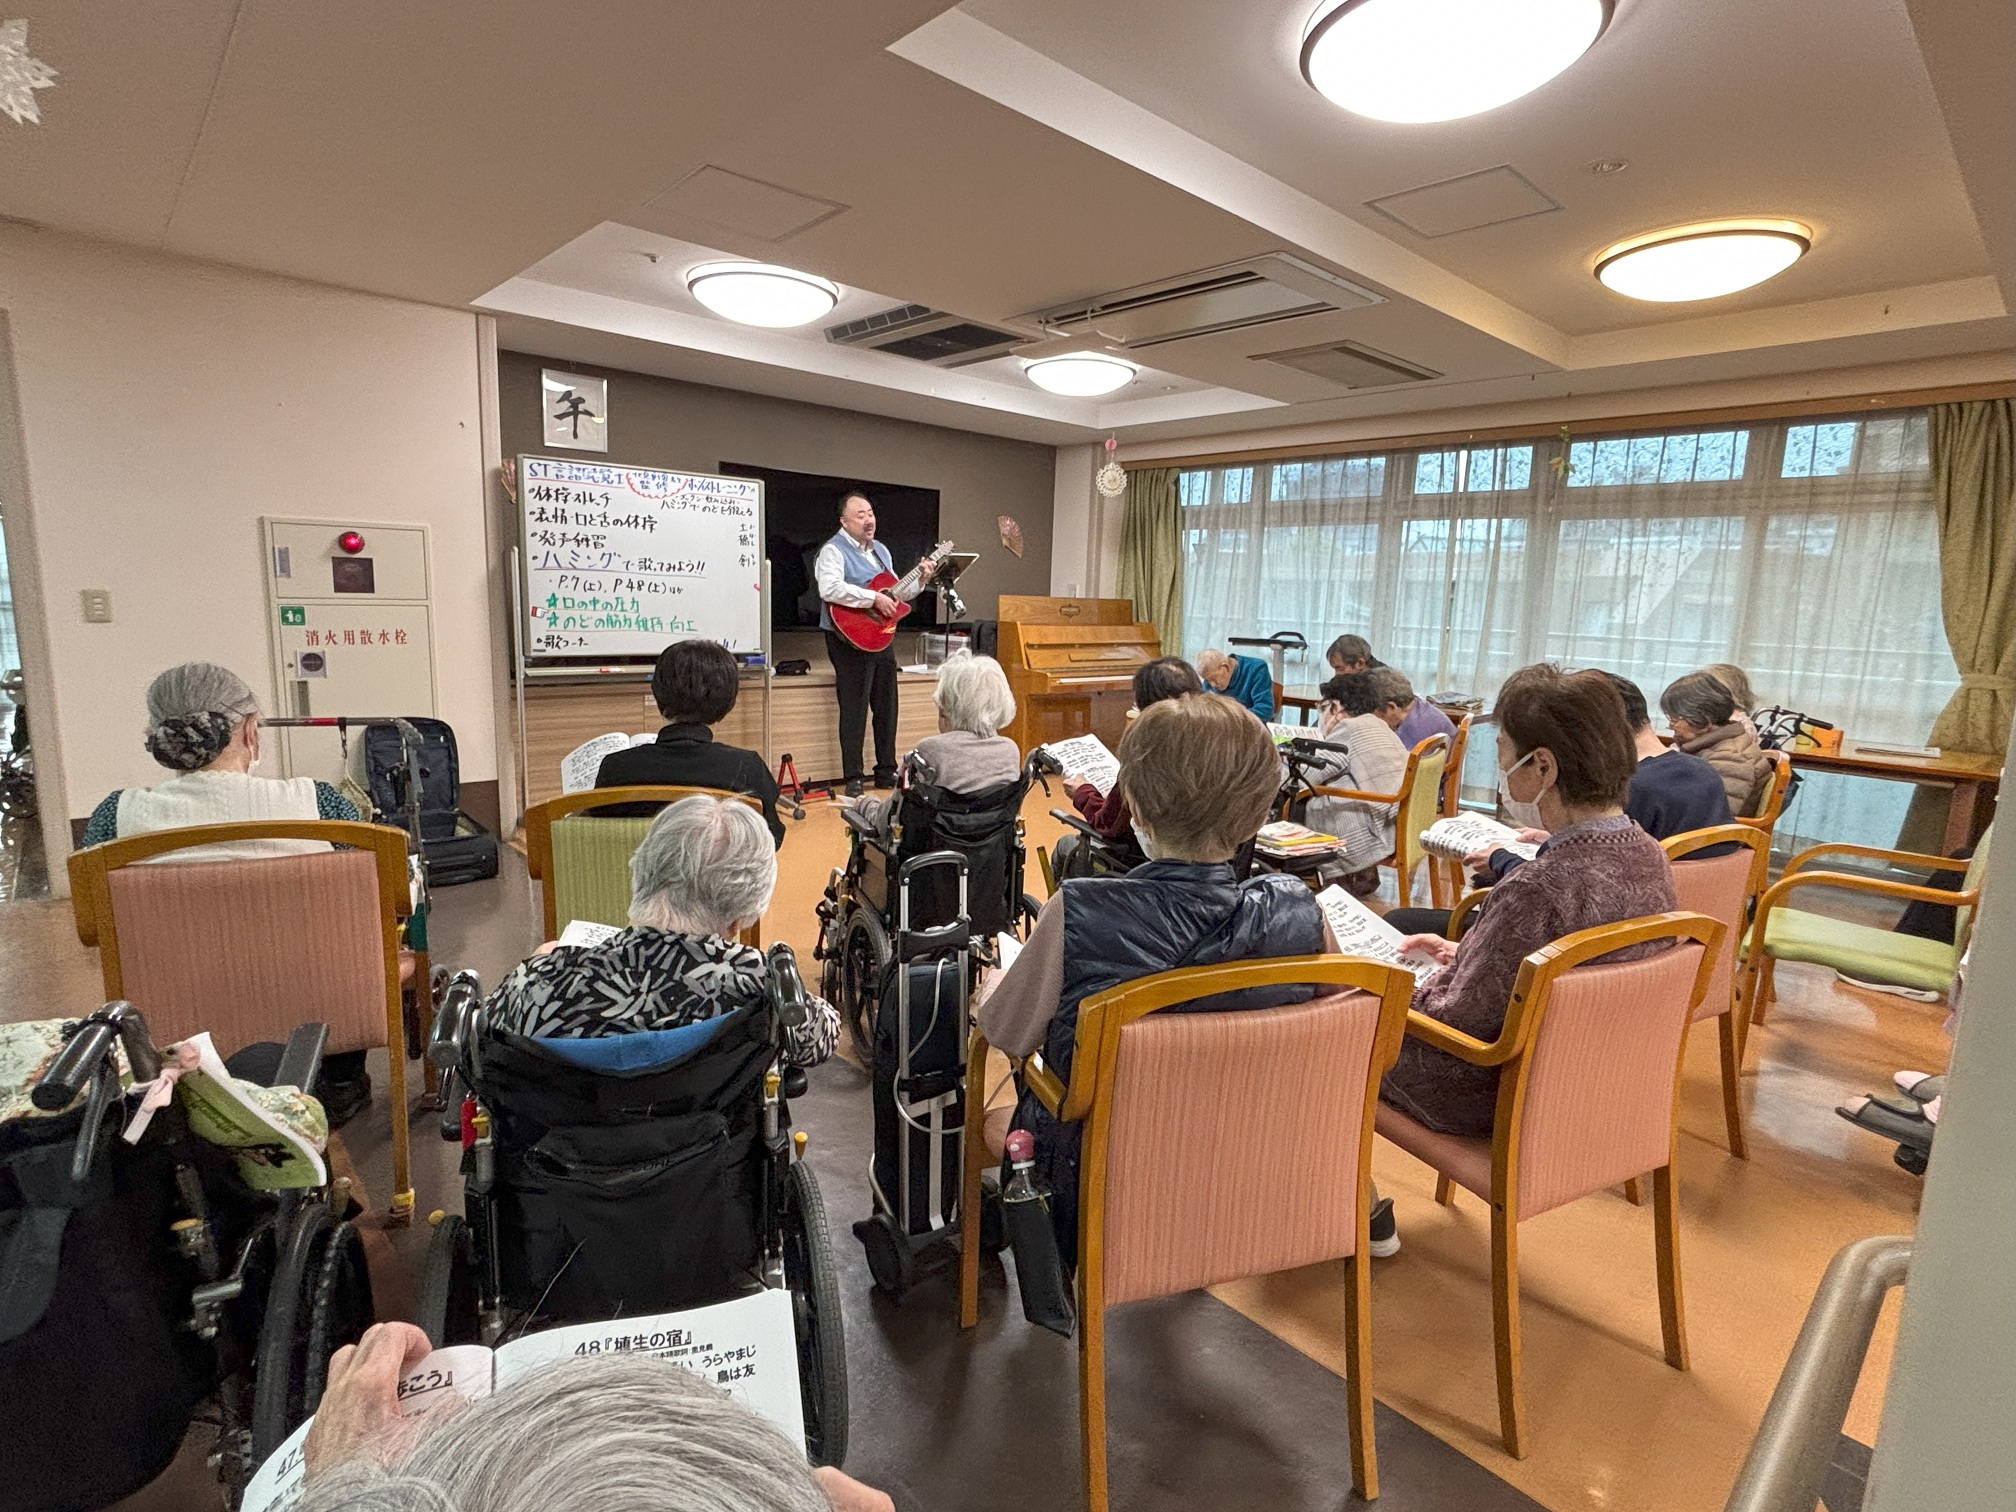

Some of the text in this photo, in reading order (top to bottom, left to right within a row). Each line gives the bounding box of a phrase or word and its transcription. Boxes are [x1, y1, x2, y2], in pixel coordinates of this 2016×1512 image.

[305, 629, 408, 647] 消火用散水栓
[702, 1345, 757, 1368] うらやまじ
[717, 1363, 756, 1384] 鳥は友
